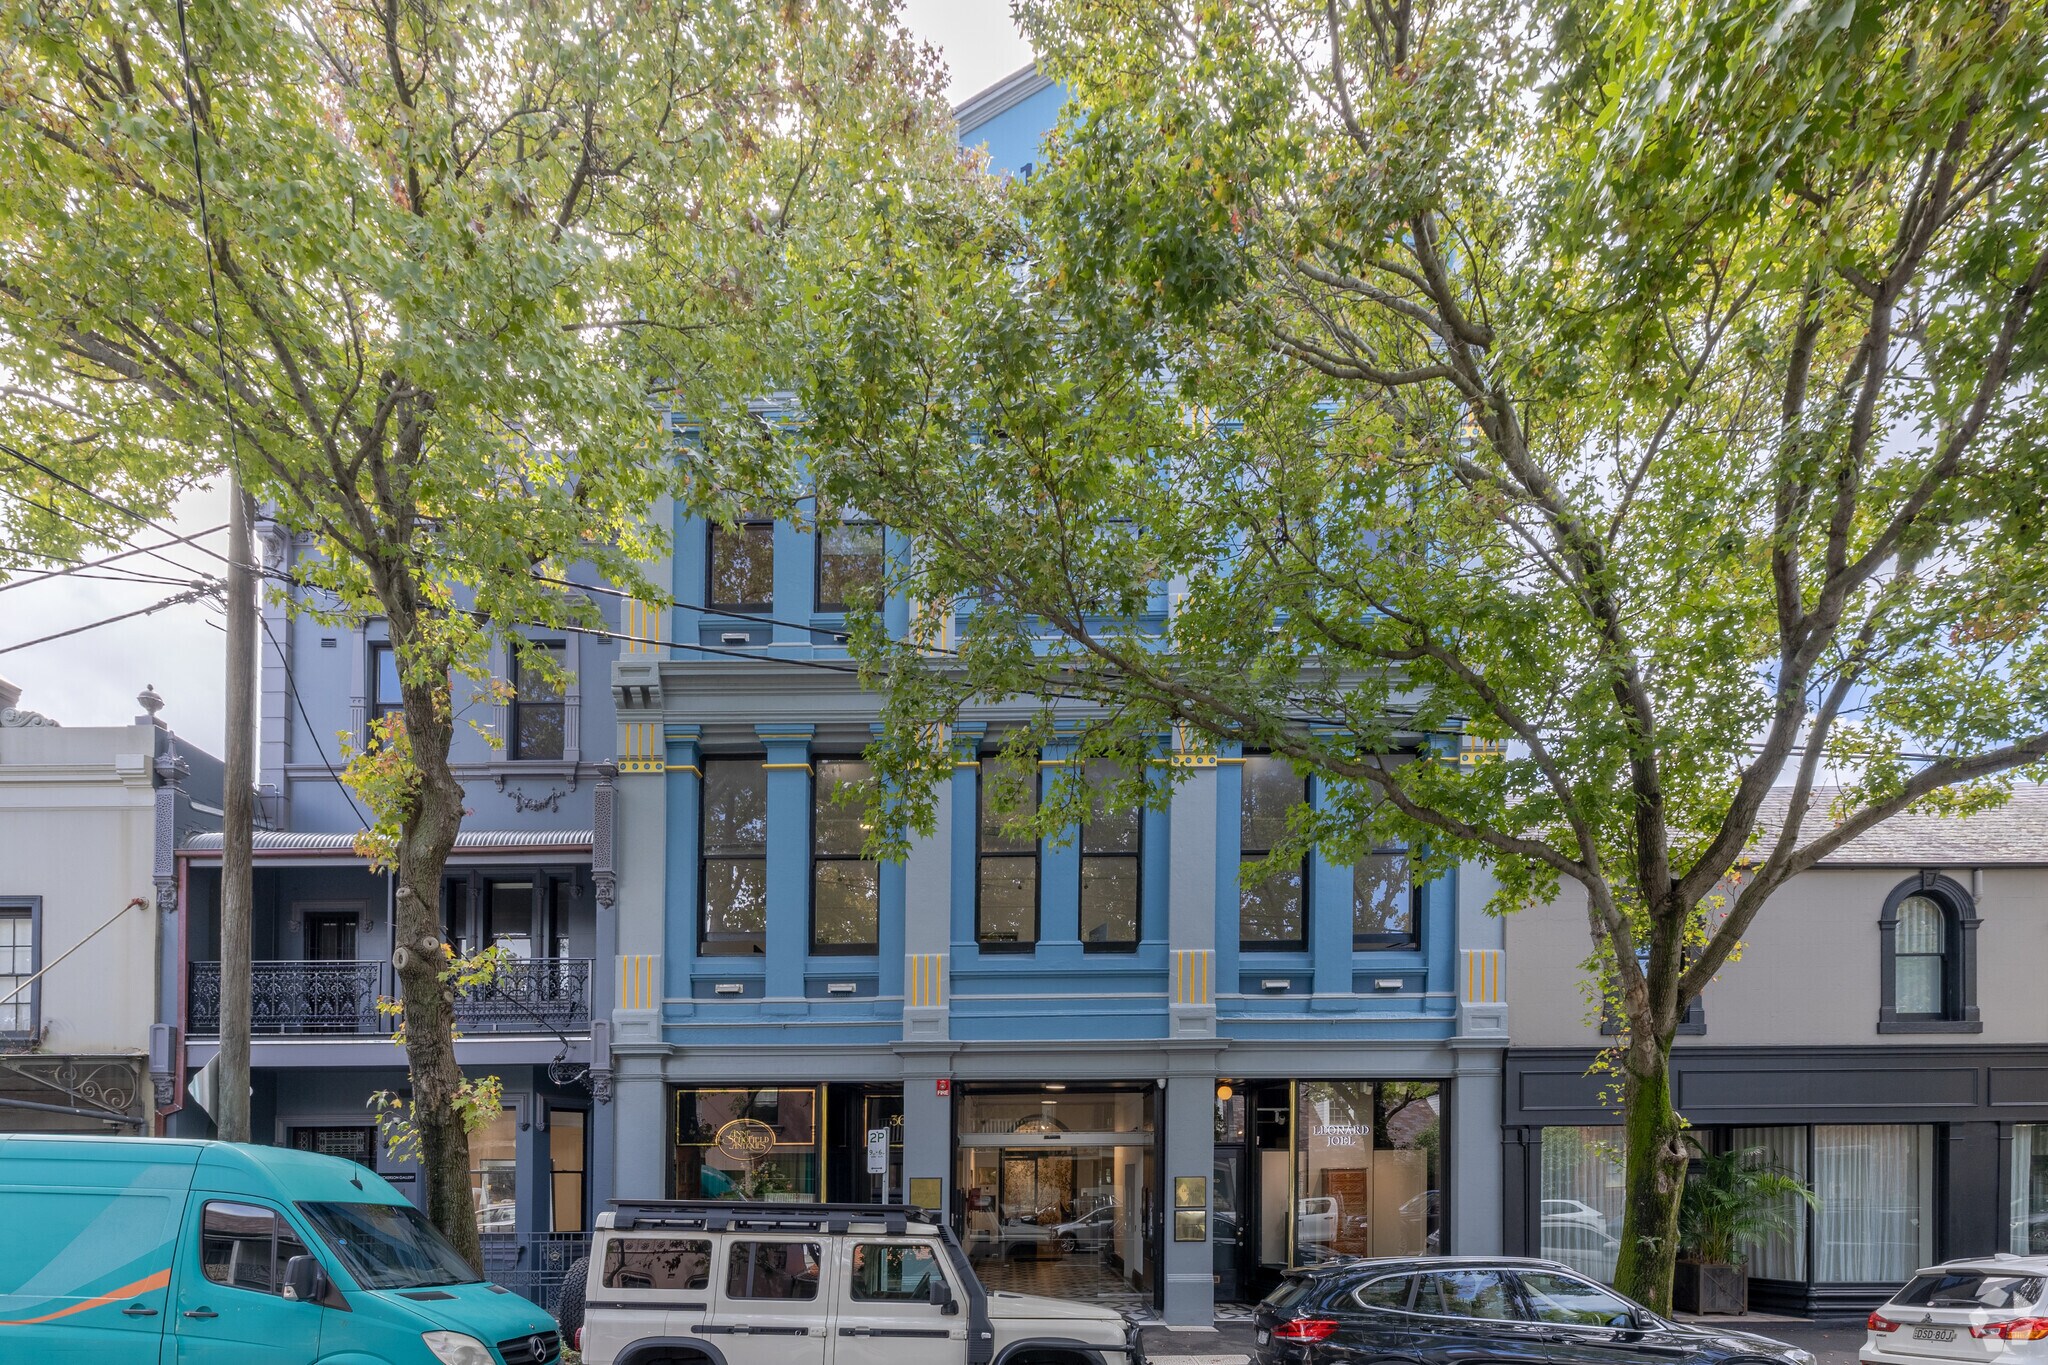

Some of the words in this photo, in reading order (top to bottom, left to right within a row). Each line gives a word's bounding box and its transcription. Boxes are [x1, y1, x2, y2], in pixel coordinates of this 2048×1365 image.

[1312, 1124, 1370, 1135] LEONARD
[870, 1133, 884, 1143] 2P
[1326, 1136, 1356, 1147] JOEL
